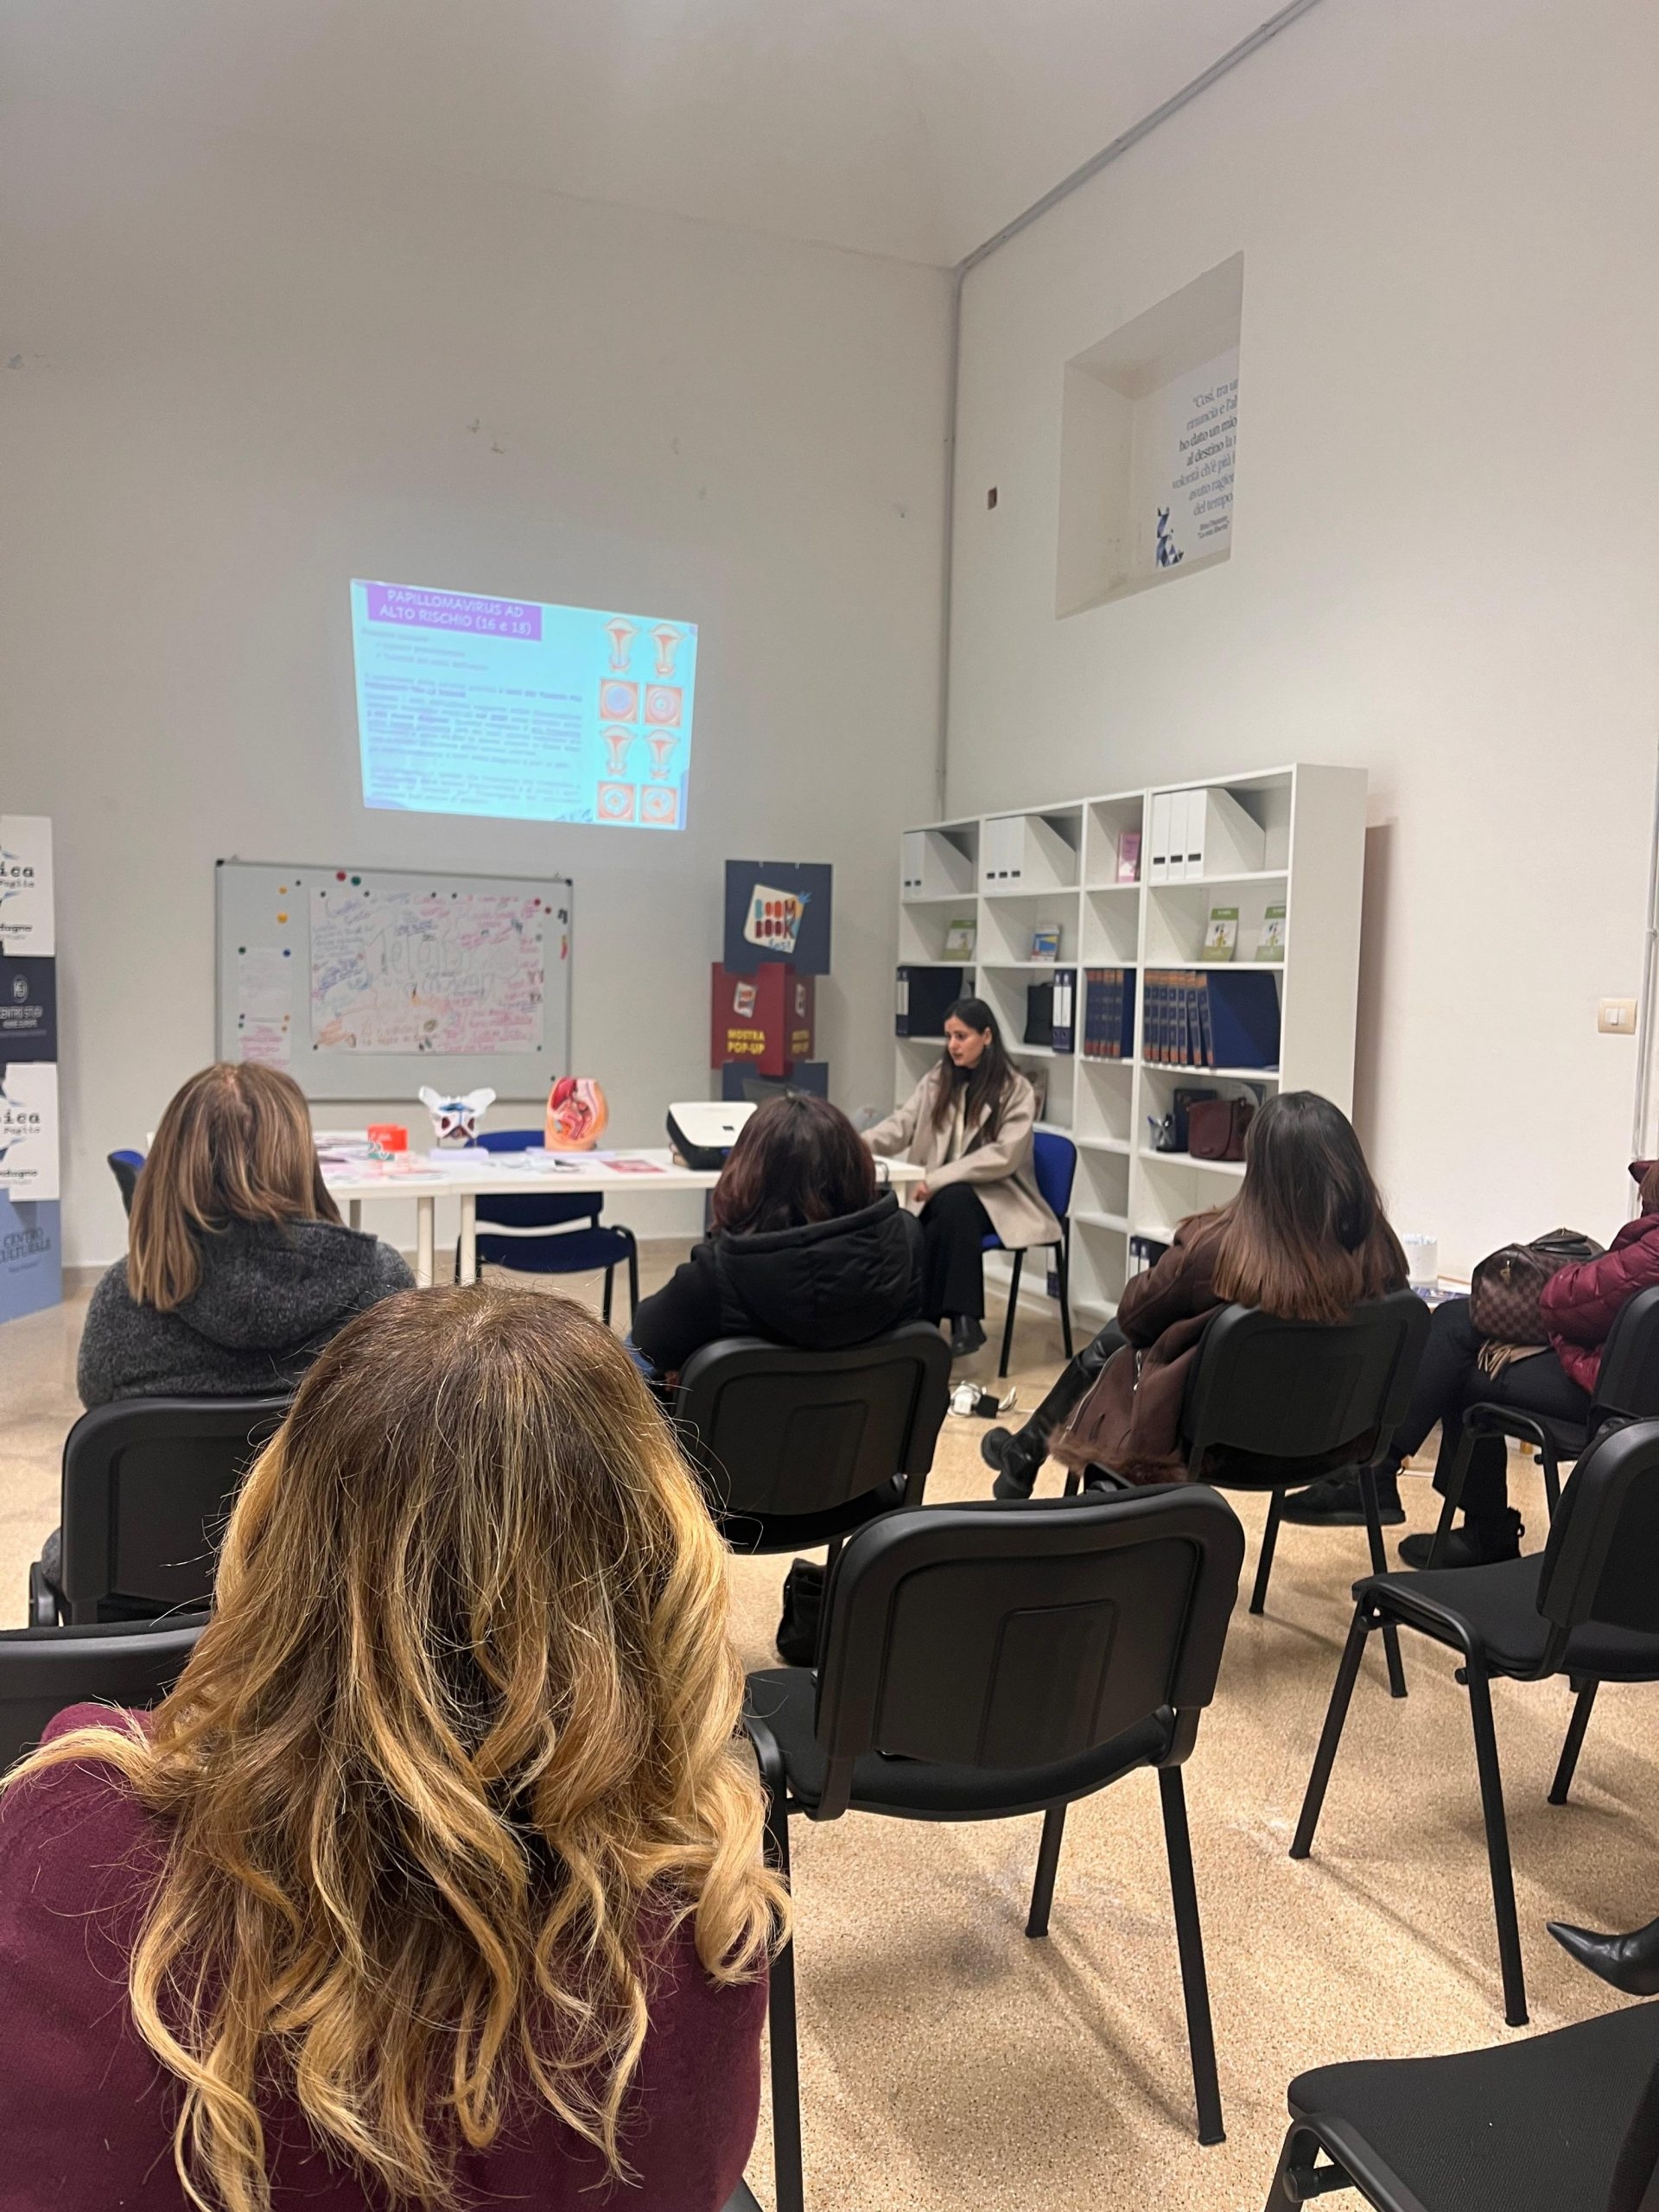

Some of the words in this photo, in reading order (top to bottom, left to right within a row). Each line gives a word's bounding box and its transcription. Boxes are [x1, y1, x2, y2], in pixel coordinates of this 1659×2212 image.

[1179, 439, 1190, 452] ho
[1190, 431, 1209, 447] dato
[1210, 425, 1220, 437] un
[1194, 442, 1224, 462] destino
[1193, 500, 1206, 516] del
[387, 589, 502, 616] PAPILLOMAVIRUS
[505, 607, 524, 619] AD
[379, 605, 416, 620] ALTO
[419, 610, 473, 627] RISCHIO
[476, 616, 496, 631] (16
[754, 919, 797, 940] BOOK
[0, 1007, 22, 1019] ENTRO
[727, 1029, 766, 1041] MOSTRA
[727, 1040, 766, 1054] POP-UP
[0, 1236, 52, 1262] ULTURALE
